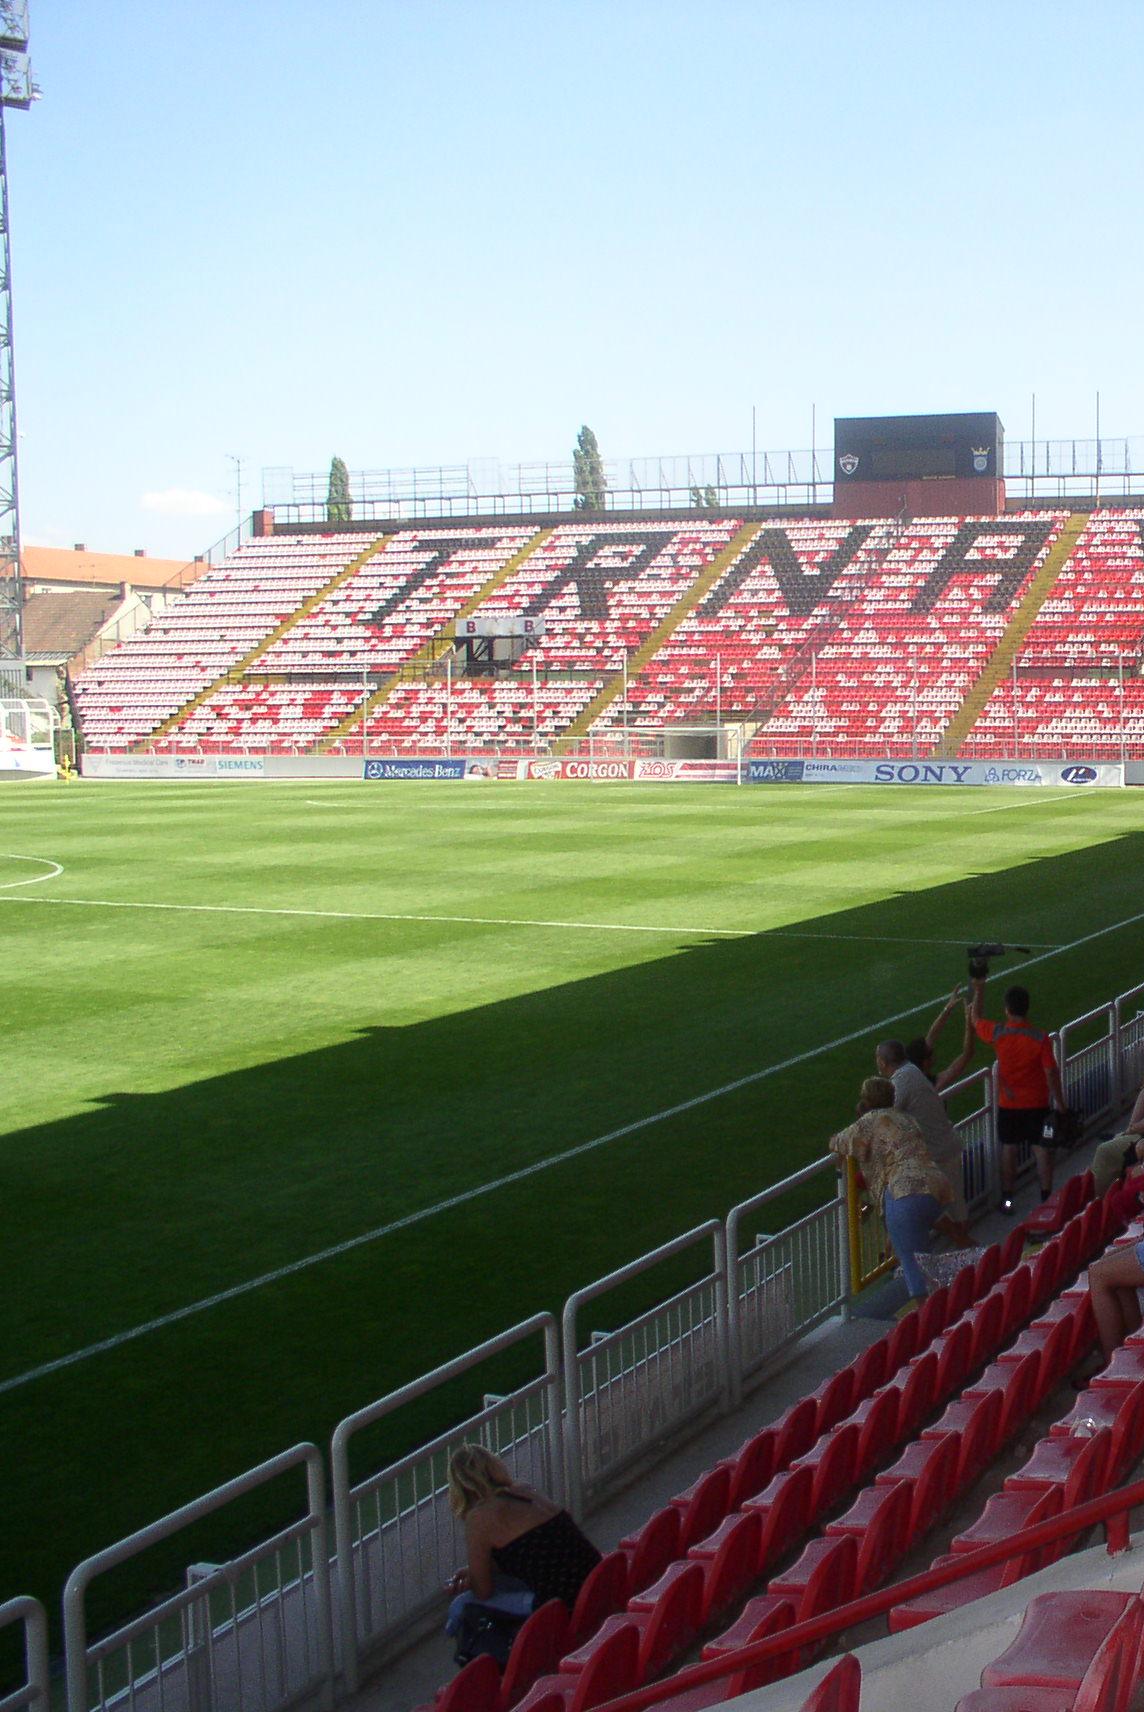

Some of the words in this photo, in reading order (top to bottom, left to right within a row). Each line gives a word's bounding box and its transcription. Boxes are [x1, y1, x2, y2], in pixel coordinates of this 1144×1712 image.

[466, 621, 476, 633] B
[524, 620, 534, 633] B
[217, 760, 264, 771] SIEMENS
[566, 762, 629, 778] CORGON
[875, 765, 972, 783] SONY
